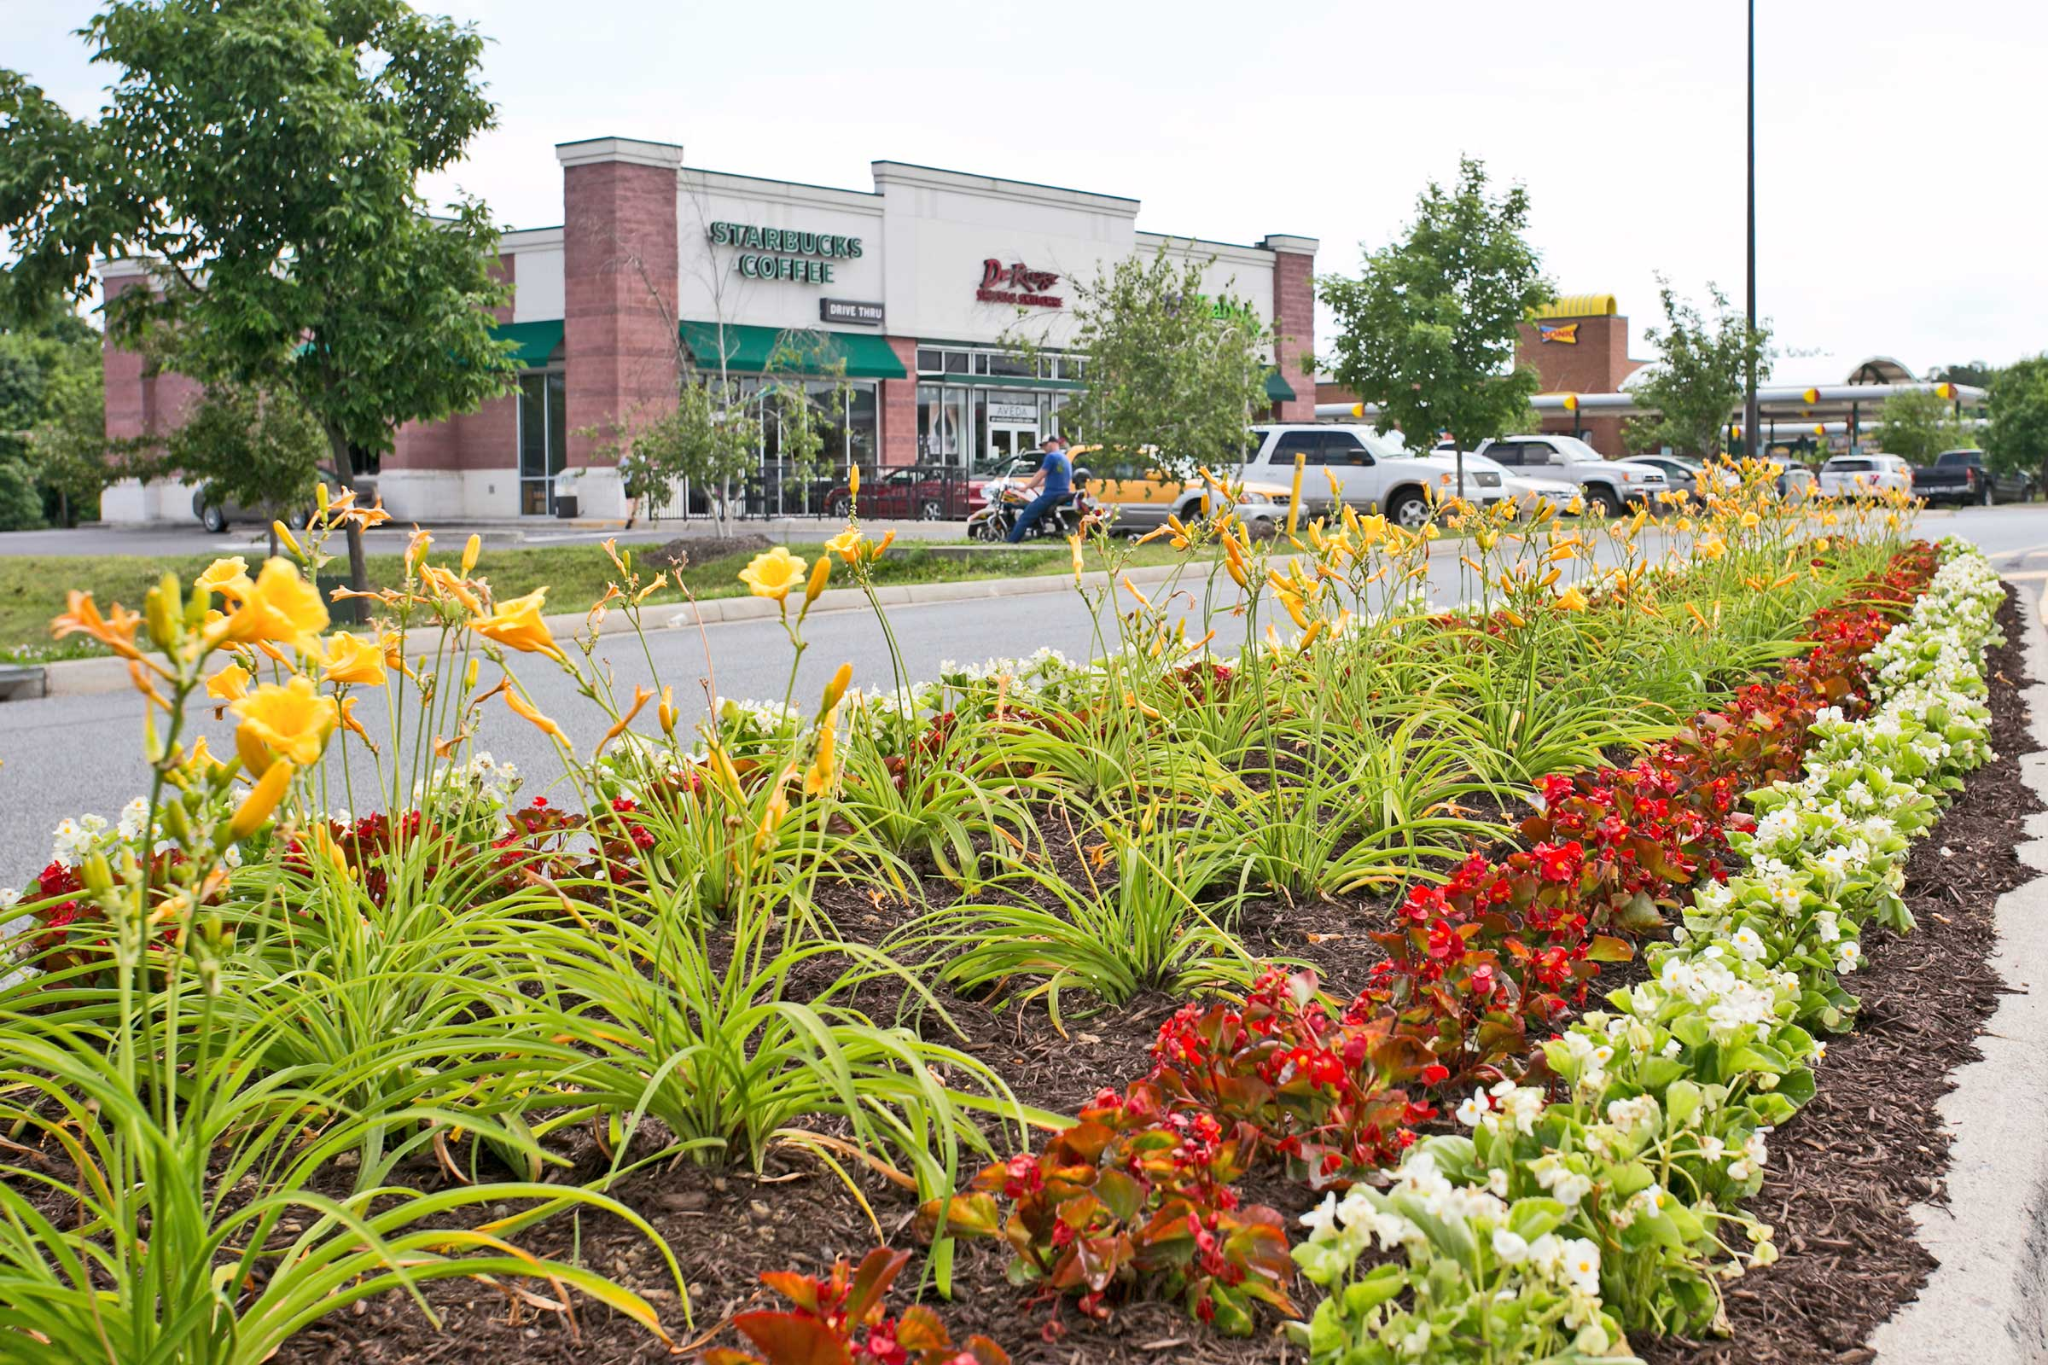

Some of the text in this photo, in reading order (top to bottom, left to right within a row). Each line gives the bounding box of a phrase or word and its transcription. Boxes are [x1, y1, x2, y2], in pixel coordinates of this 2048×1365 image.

[711, 221, 863, 259] STARBUCKS
[738, 254, 836, 285] COFFEE
[830, 303, 882, 319] DRIVE THRU
[1543, 330, 1574, 340] SONIC
[997, 406, 1028, 416] AVEDA
